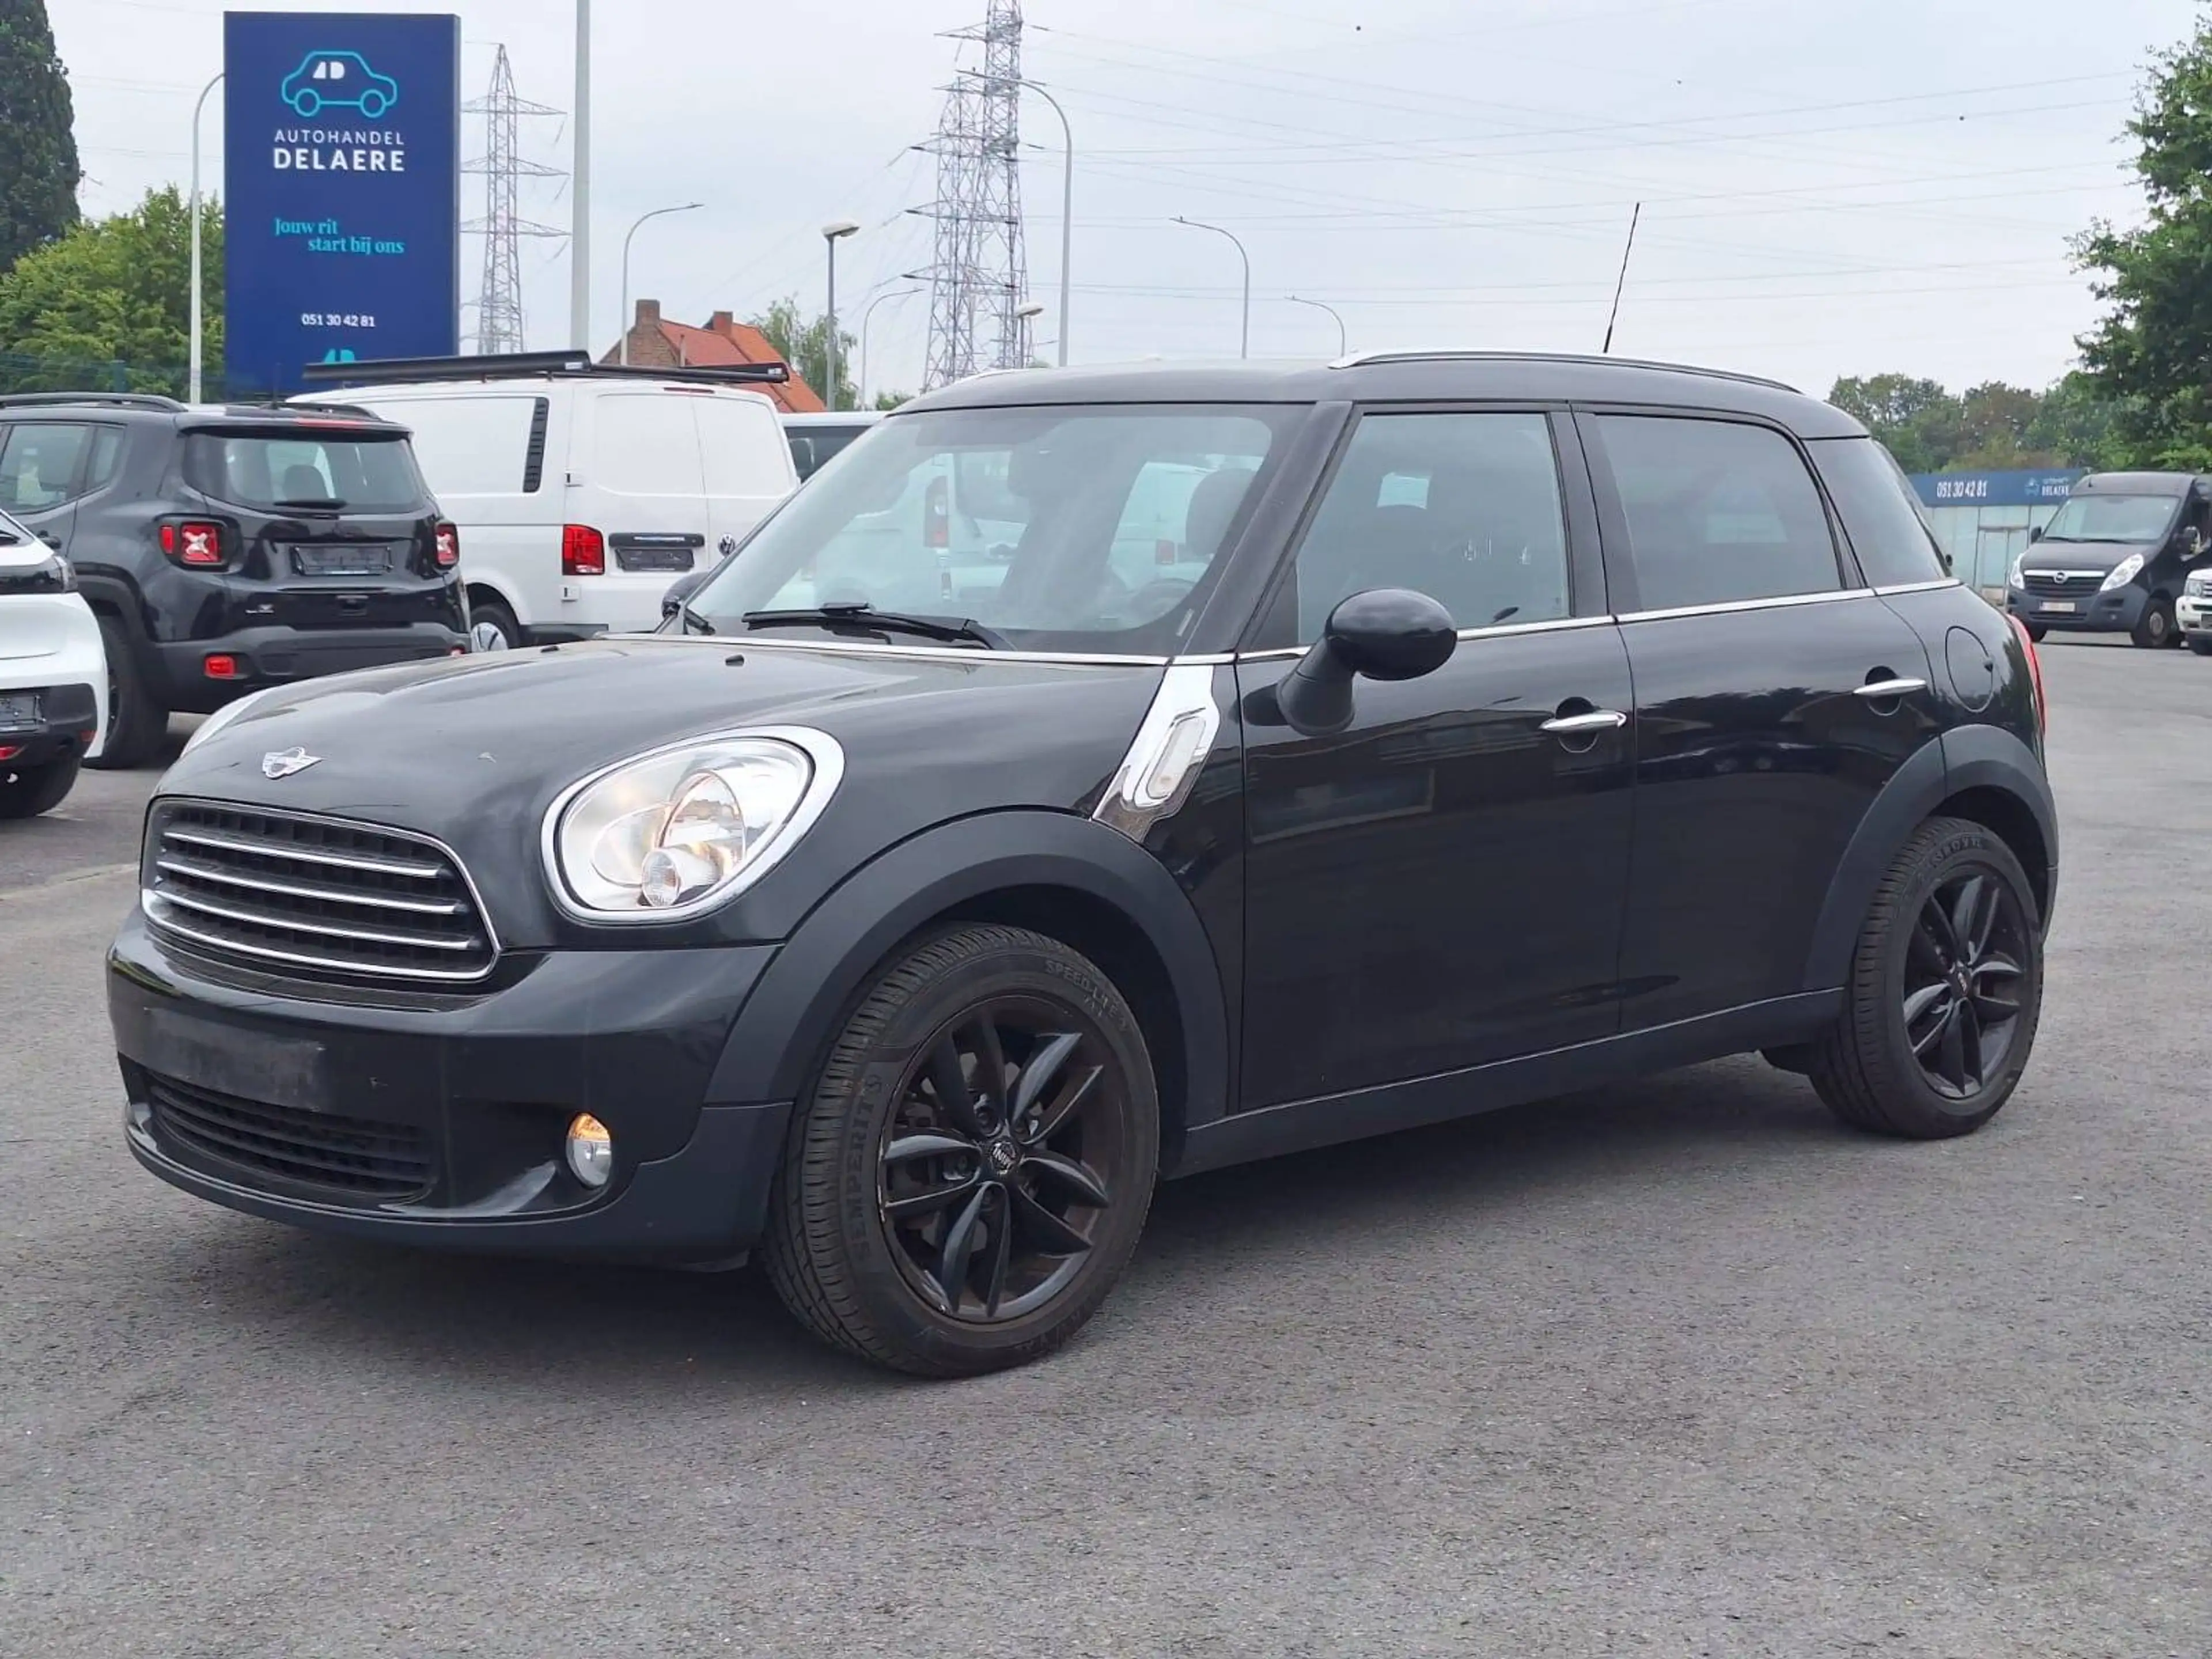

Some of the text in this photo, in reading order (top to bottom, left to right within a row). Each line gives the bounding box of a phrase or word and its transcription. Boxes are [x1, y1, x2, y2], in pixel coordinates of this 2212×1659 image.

[274, 129, 404, 145] AUTOHANDEL
[274, 147, 405, 171] DELAERE
[275, 218, 338, 236] Jouw rit
[308, 236, 406, 255] start bij ons
[301, 313, 376, 327] 051 30 42 81
[1937, 479, 1987, 498] 051 30 42 81
